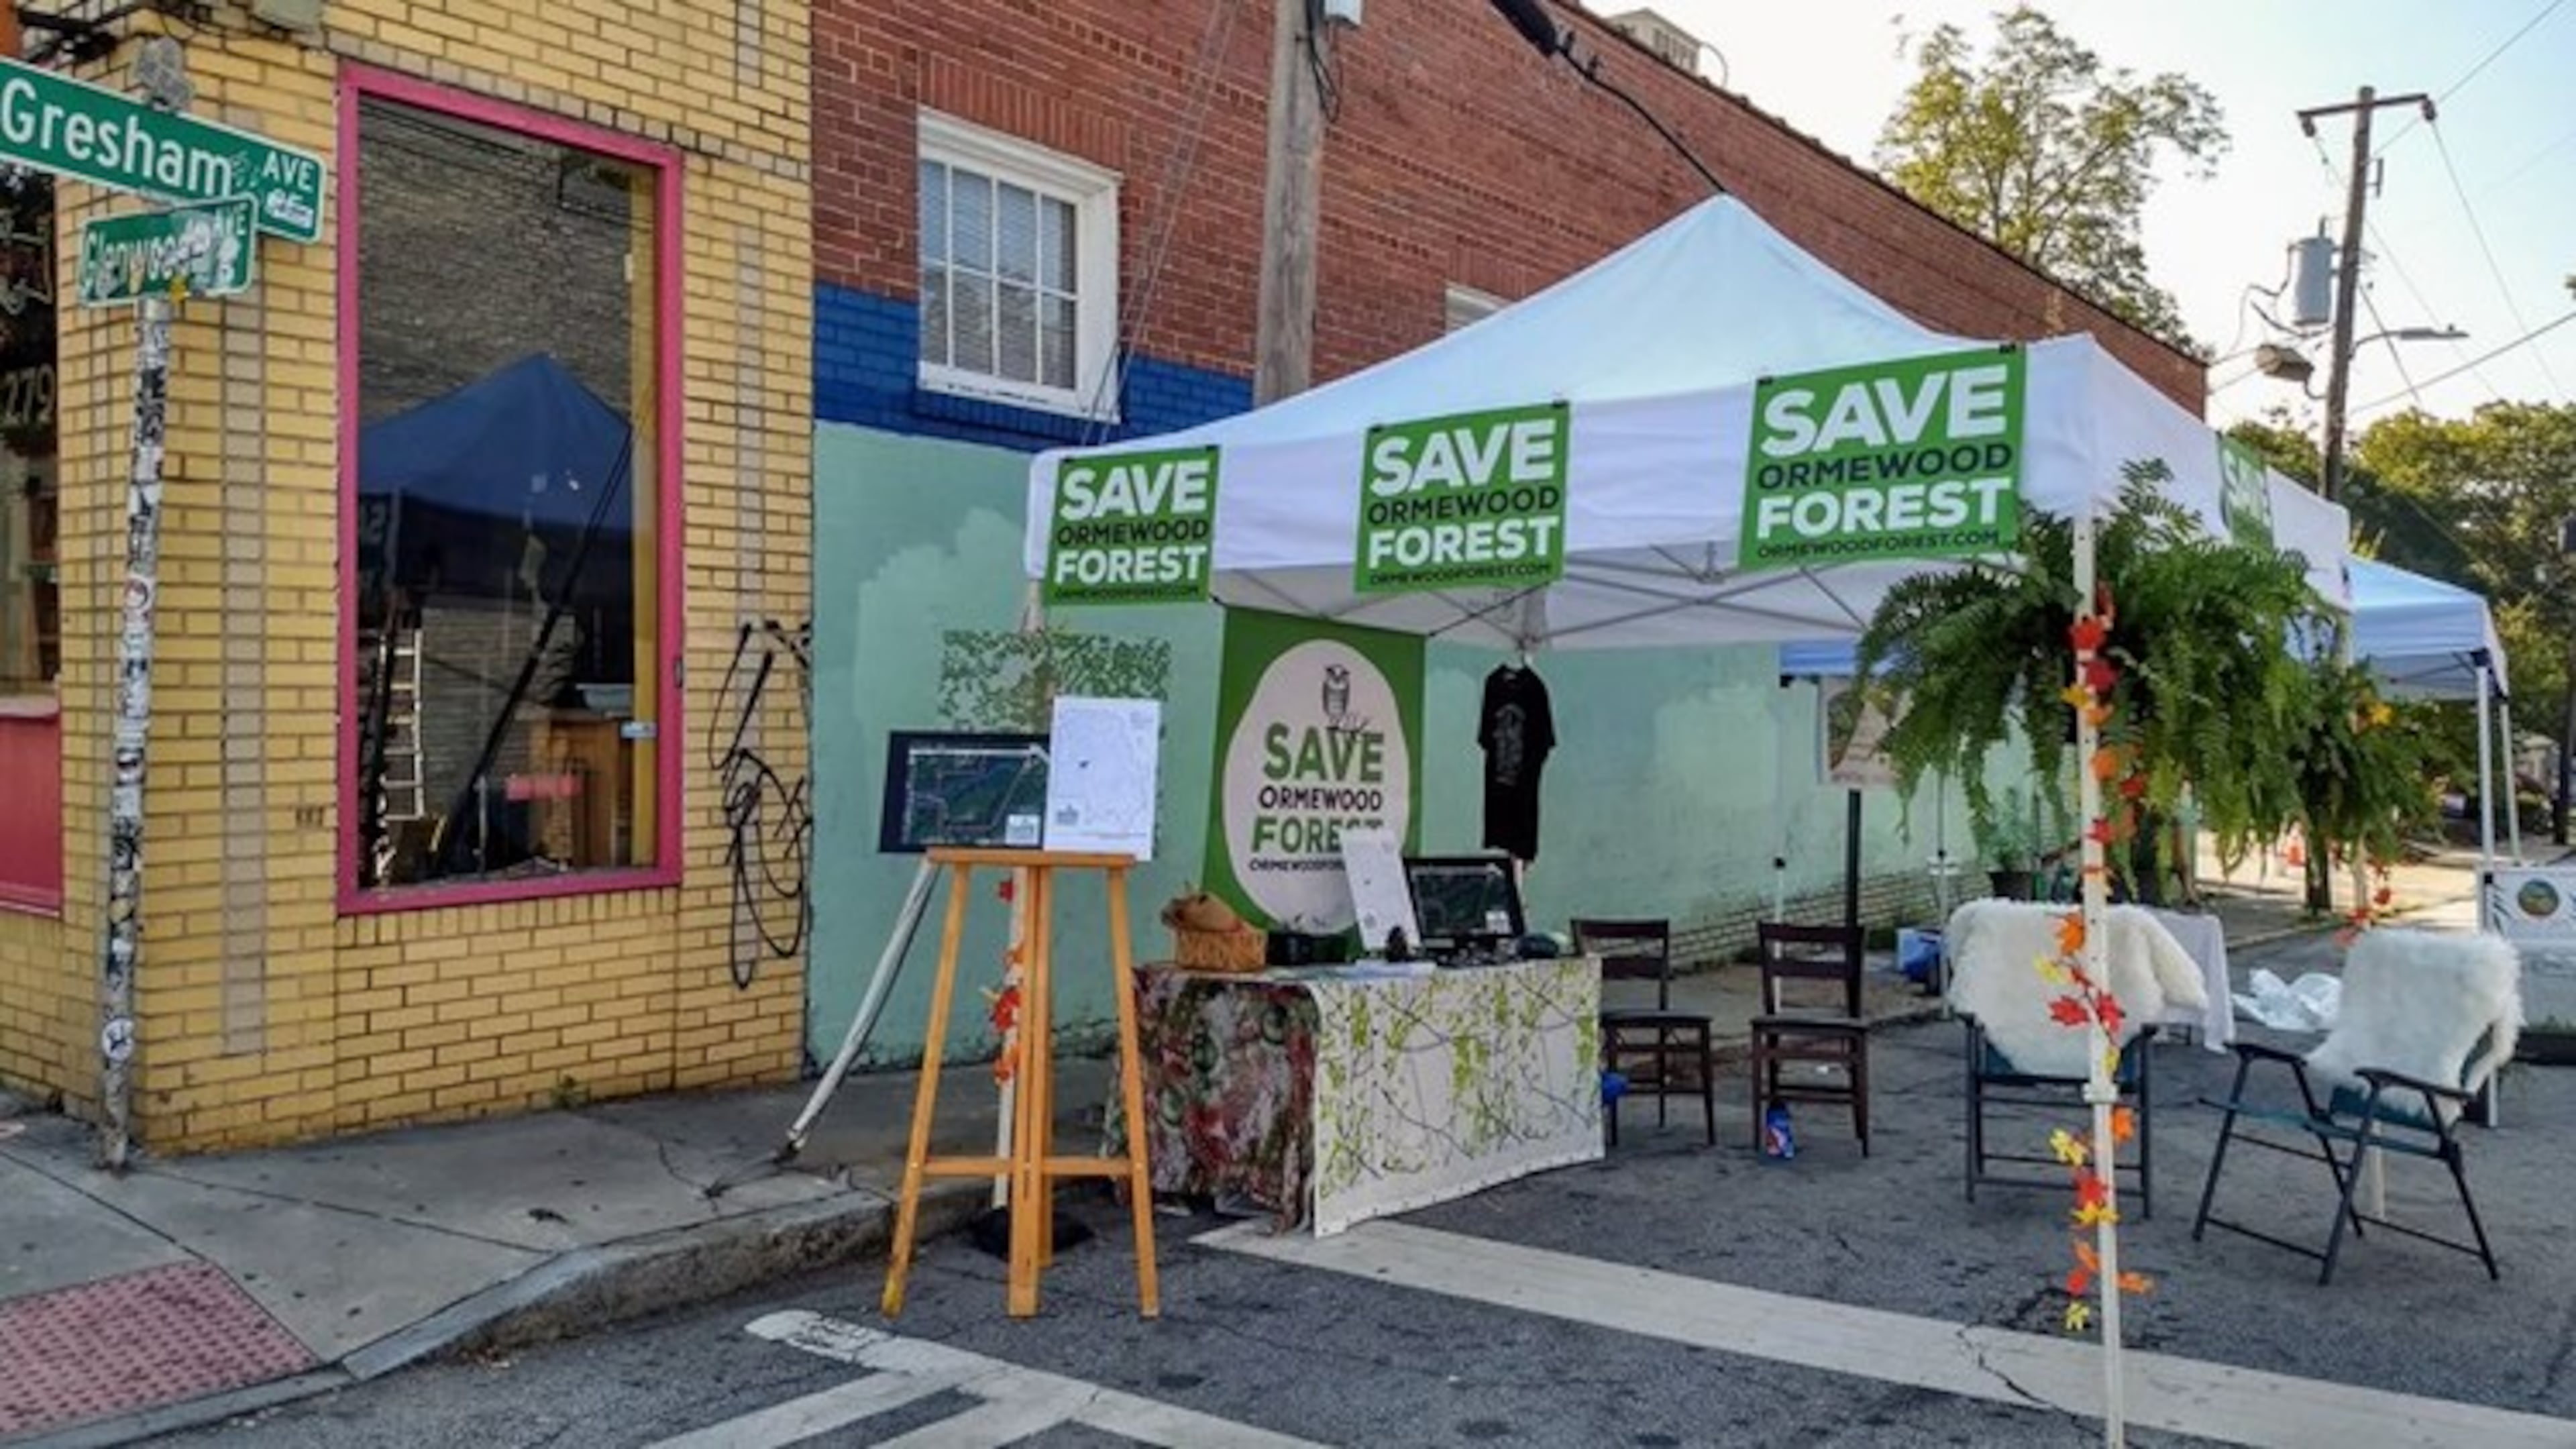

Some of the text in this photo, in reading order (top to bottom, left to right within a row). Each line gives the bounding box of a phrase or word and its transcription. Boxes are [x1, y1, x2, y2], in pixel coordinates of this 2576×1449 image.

[1, 77, 314, 197] Gresham AVE
[1760, 364, 2008, 458] SAVE
[1369, 418, 1557, 497] SAVE
[1756, 442, 2012, 490] ORMEWOOD
[1059, 459, 1210, 521] SAVE
[1367, 484, 1560, 525] ORMEWOOD
[1756, 476, 2012, 538] FOREST
[1057, 519, 1208, 545] ORMEWOOD
[1367, 515, 1560, 570] FOREST
[1757, 529, 2000, 558] ORMEWOODFOREST.COM
[1054, 545, 1207, 585] FOREST
[1263, 722, 1384, 784] SAVE
[1258, 786, 1383, 811] ORMEWOOD
[1252, 816, 1383, 854] FORE
